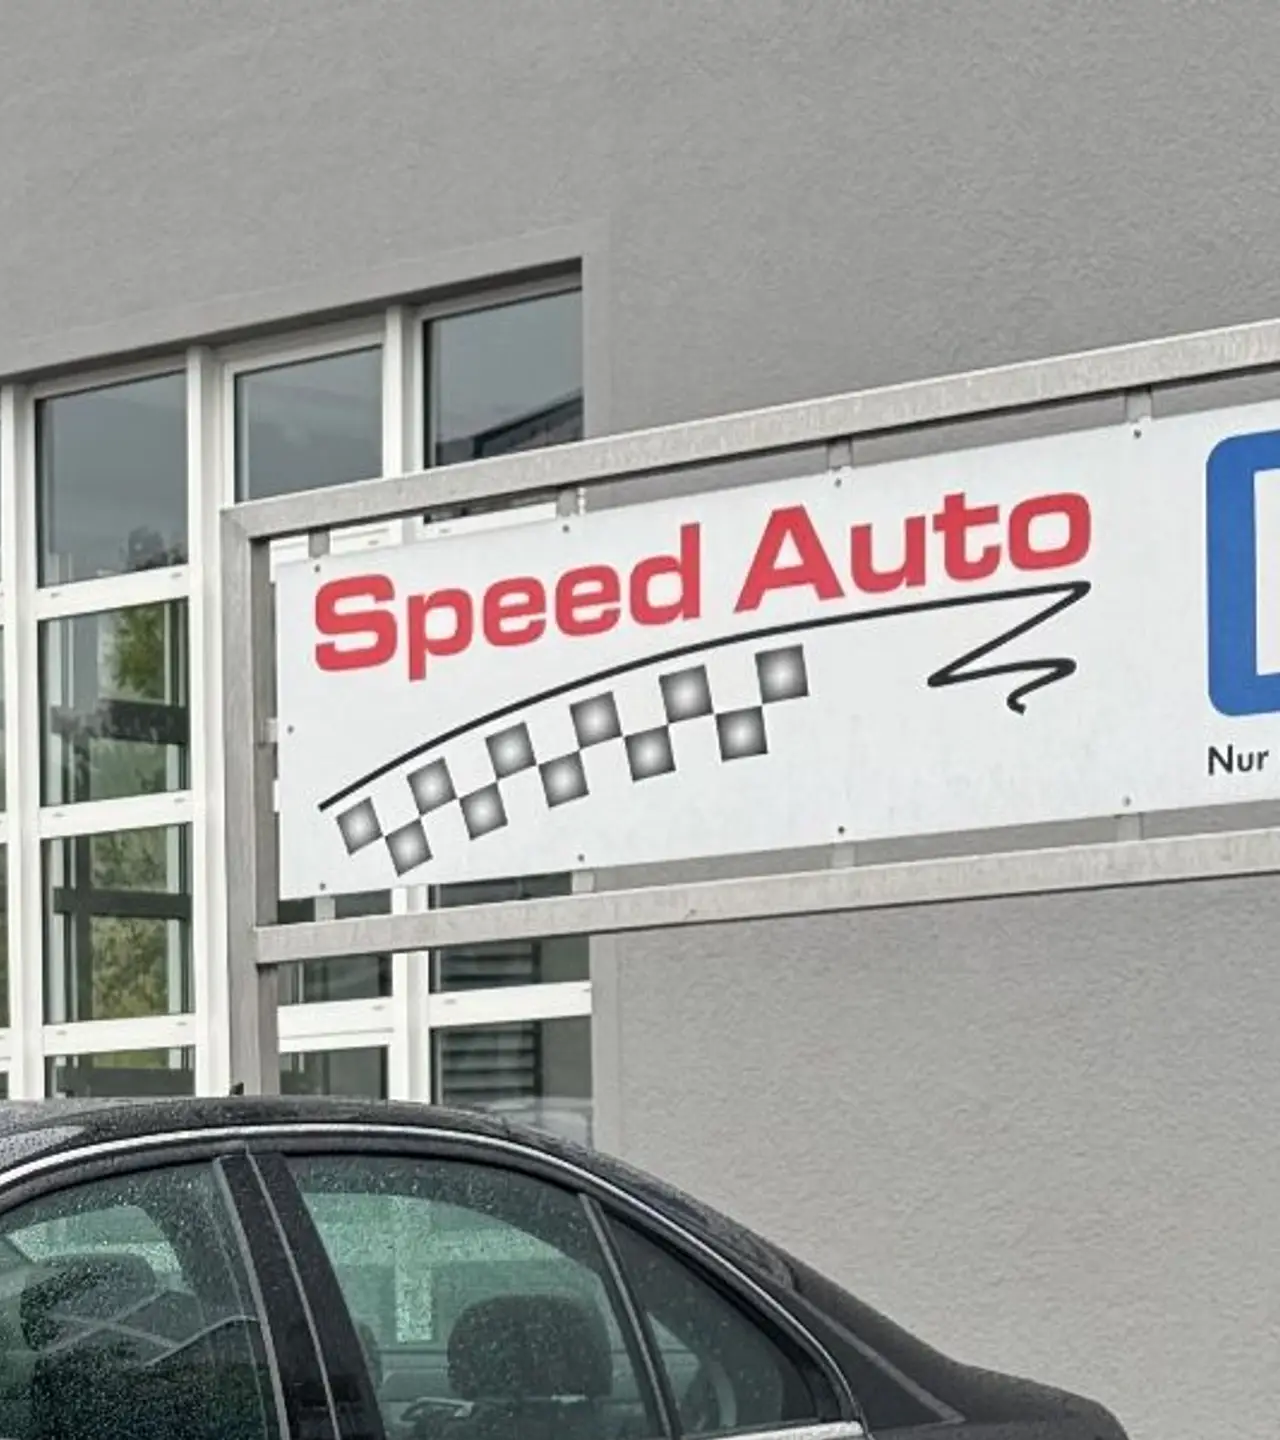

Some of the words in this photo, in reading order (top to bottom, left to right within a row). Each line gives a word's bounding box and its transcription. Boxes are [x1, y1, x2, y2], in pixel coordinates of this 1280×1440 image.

[313, 523, 702, 683] Speed
[736, 491, 1092, 613] Auto
[1207, 743, 1270, 776] Nur
